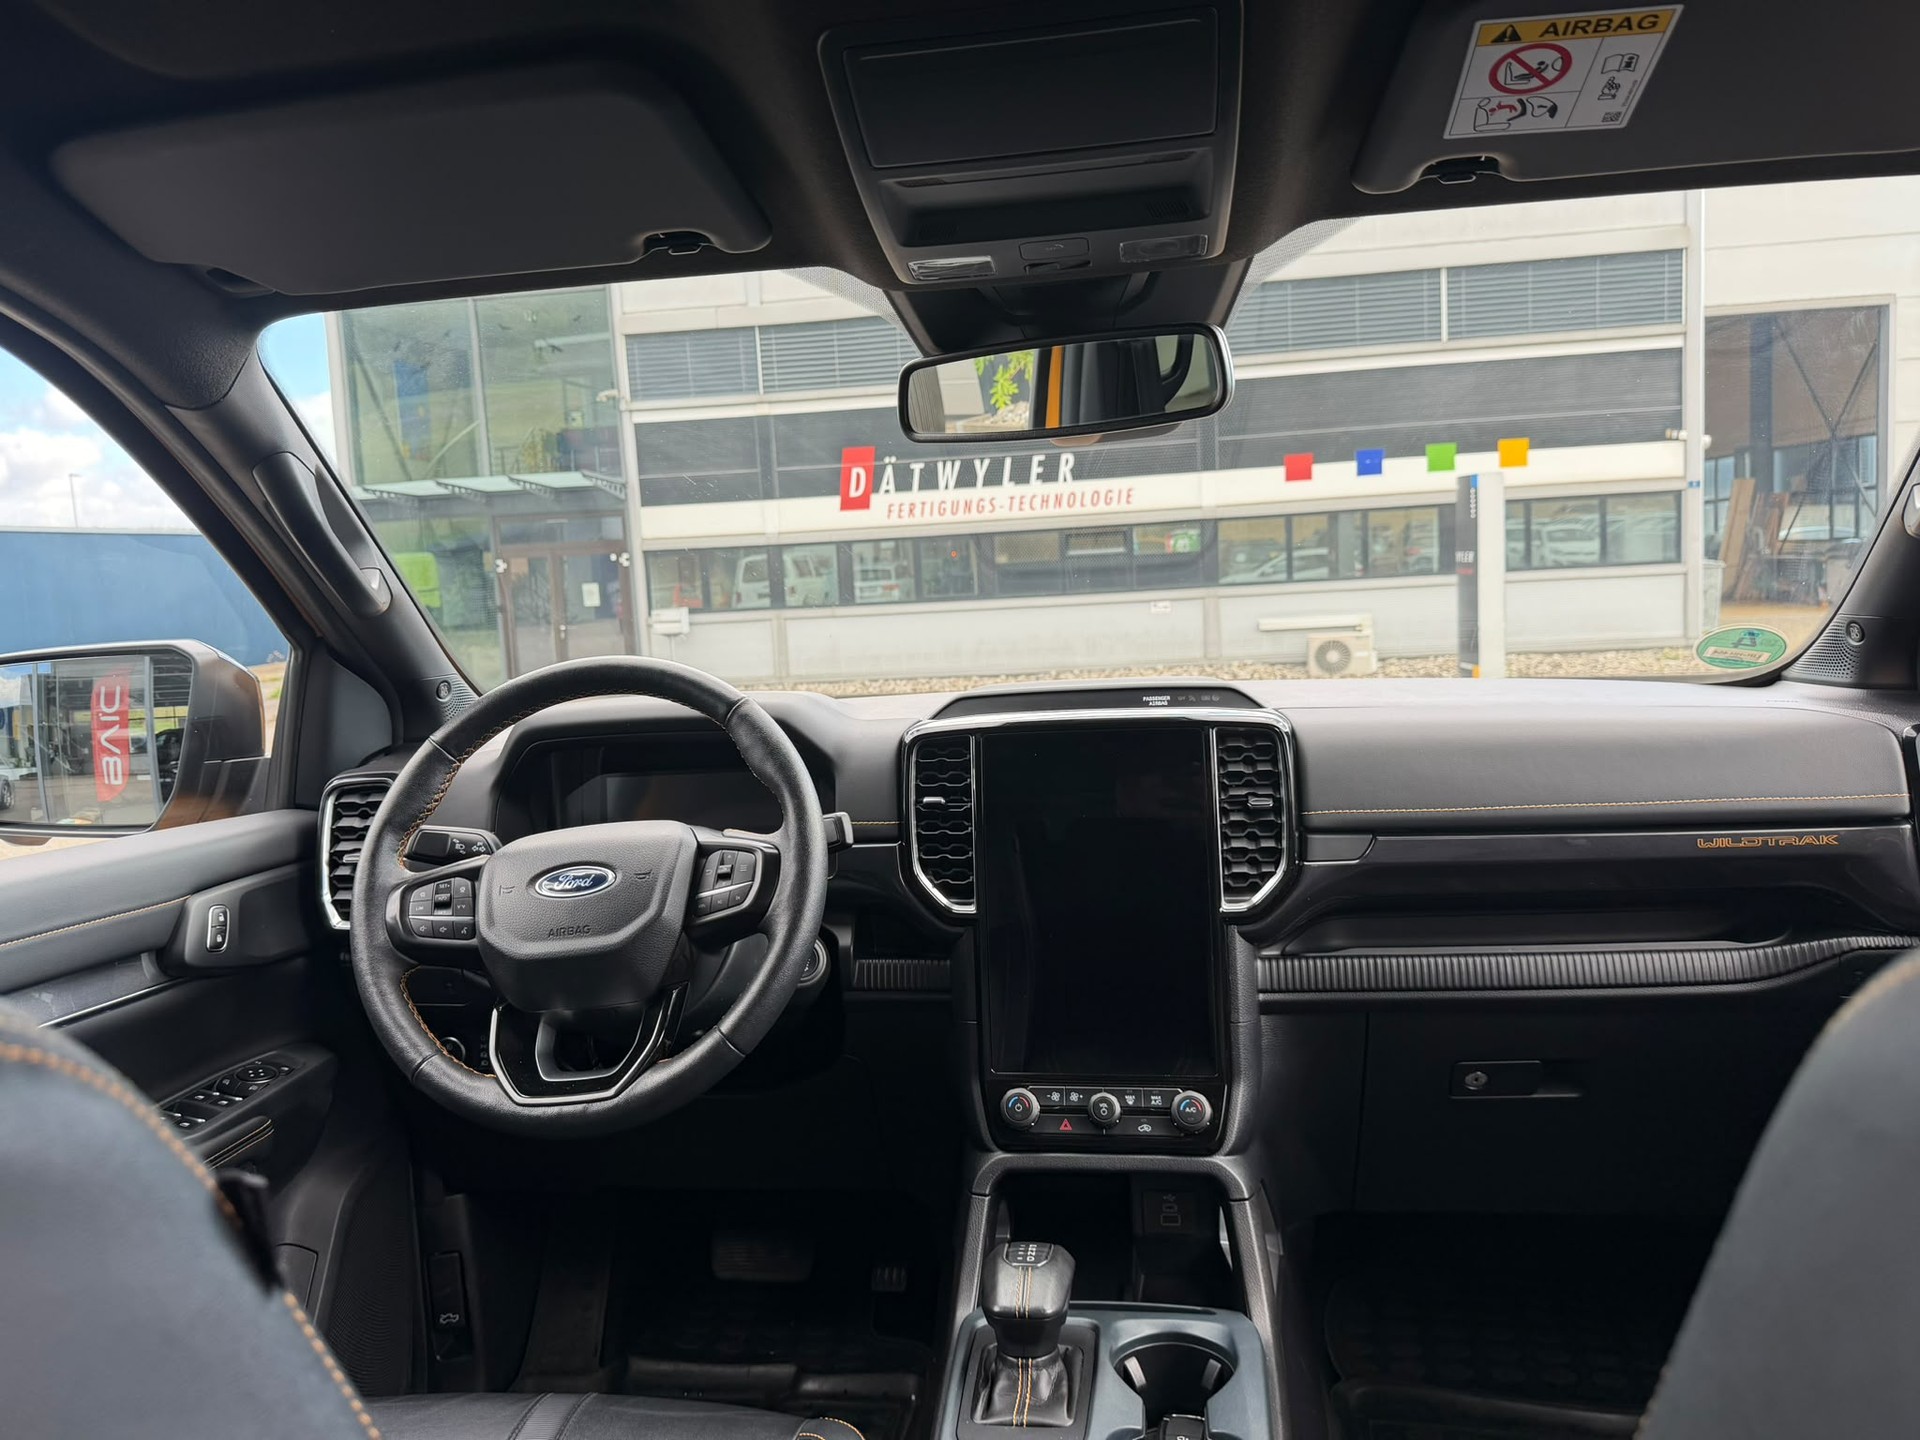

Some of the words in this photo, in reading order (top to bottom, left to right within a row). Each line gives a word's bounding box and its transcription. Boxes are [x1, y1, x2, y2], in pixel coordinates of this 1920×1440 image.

[1539, 14, 1660, 38] AIRBAG
[848, 453, 1076, 498] DÄTWYLER
[886, 487, 1136, 519] FERTIGUNGS-TECHNOLOGIE
[100, 685, 123, 785] BAIC
[1696, 834, 1839, 849] WILDTRAK
[553, 873, 596, 890] Ford
[548, 924, 592, 938] AIRBAG
